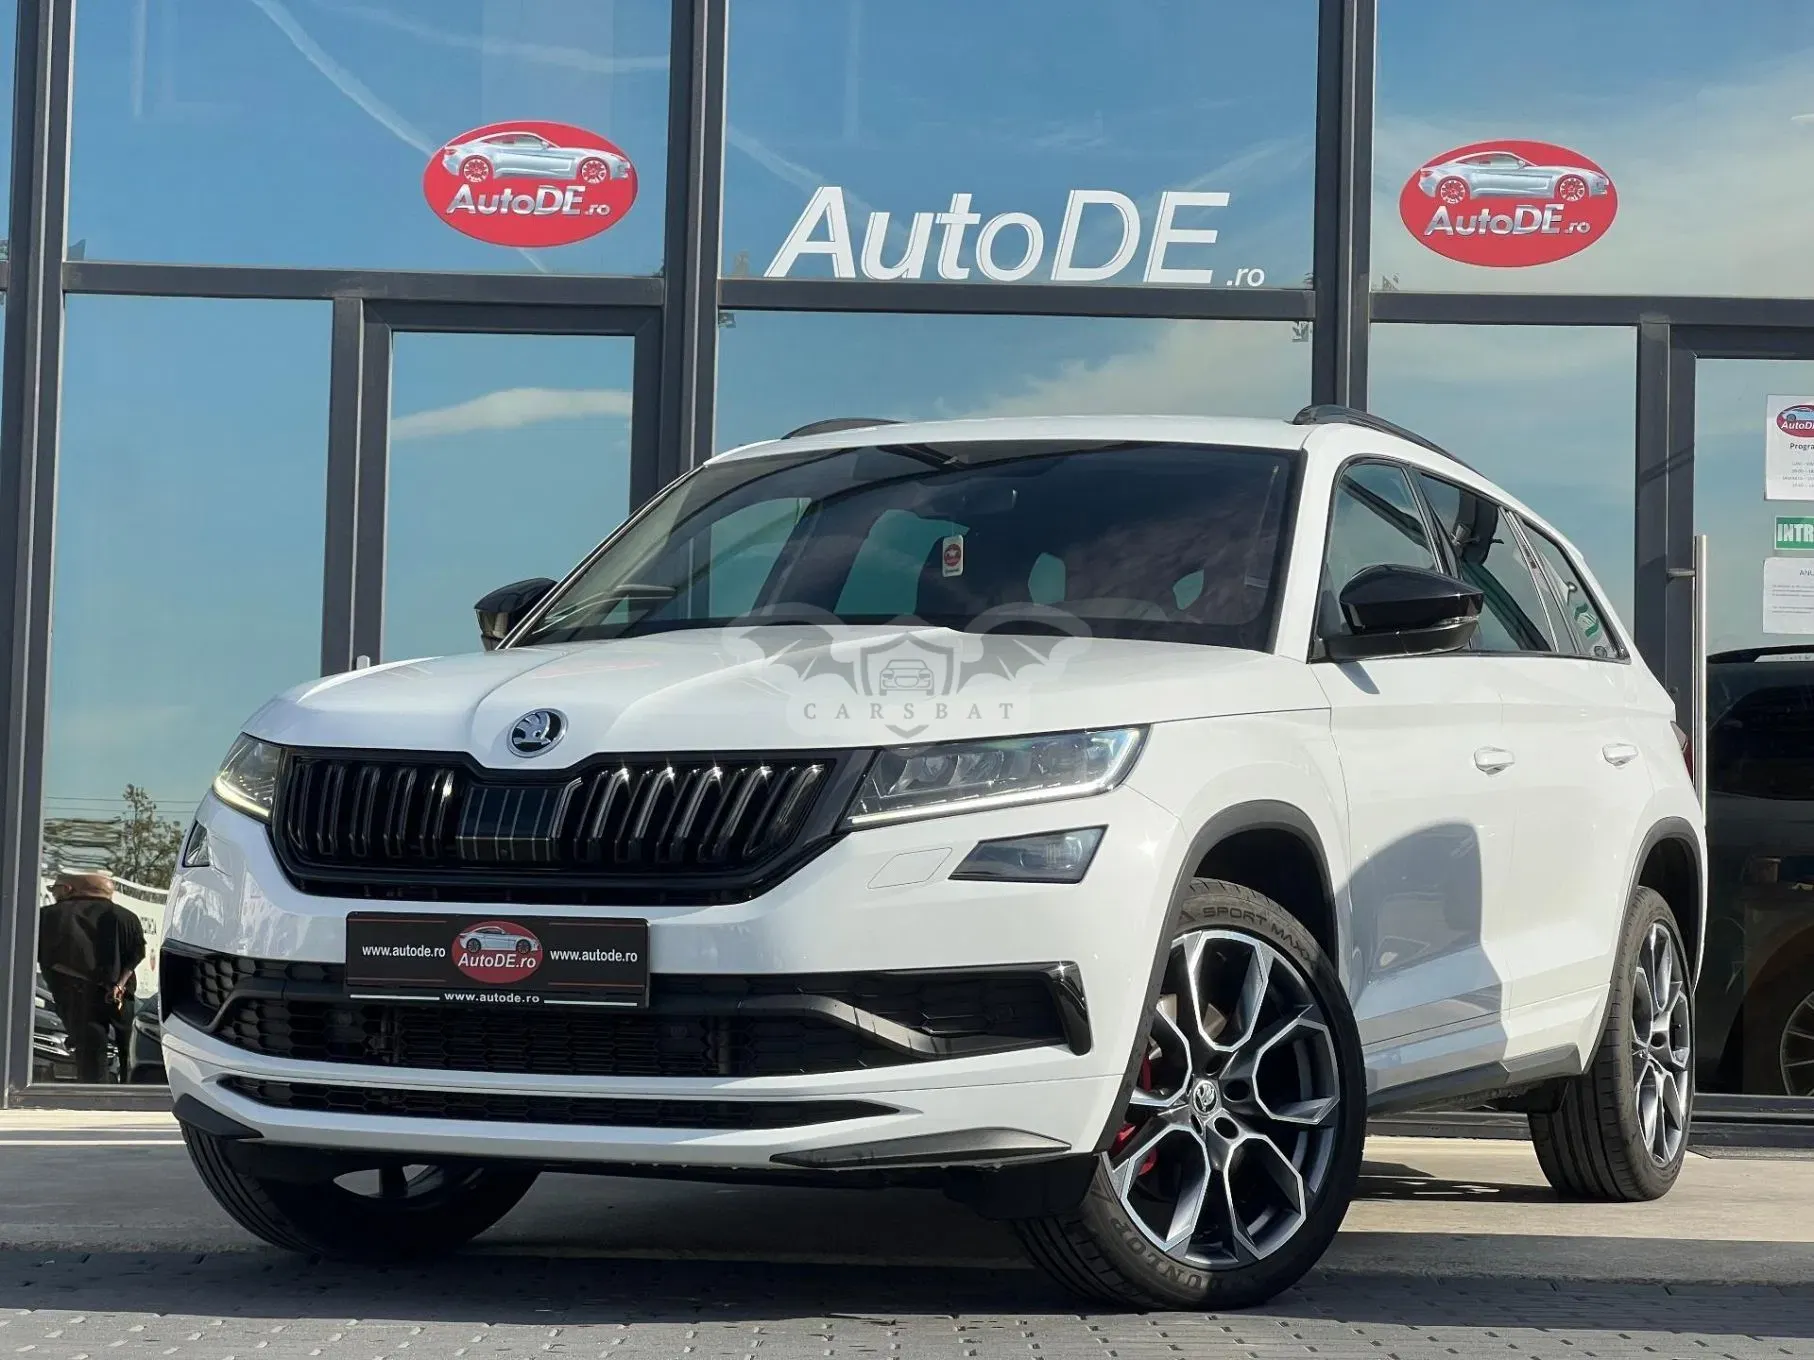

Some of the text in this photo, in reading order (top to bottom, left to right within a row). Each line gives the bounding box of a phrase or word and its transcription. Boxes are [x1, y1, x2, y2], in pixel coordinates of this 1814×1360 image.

[763, 186, 1230, 282] AutoDE
[1777, 523, 1814, 542] INTR
[1203, 906, 1267, 925] SPORT
[362, 944, 446, 958] www.autode.ro
[550, 949, 638, 963] www.autode.ro
[458, 952, 536, 968] AutoDE.ro
[444, 991, 540, 1004] www.autode.ro
